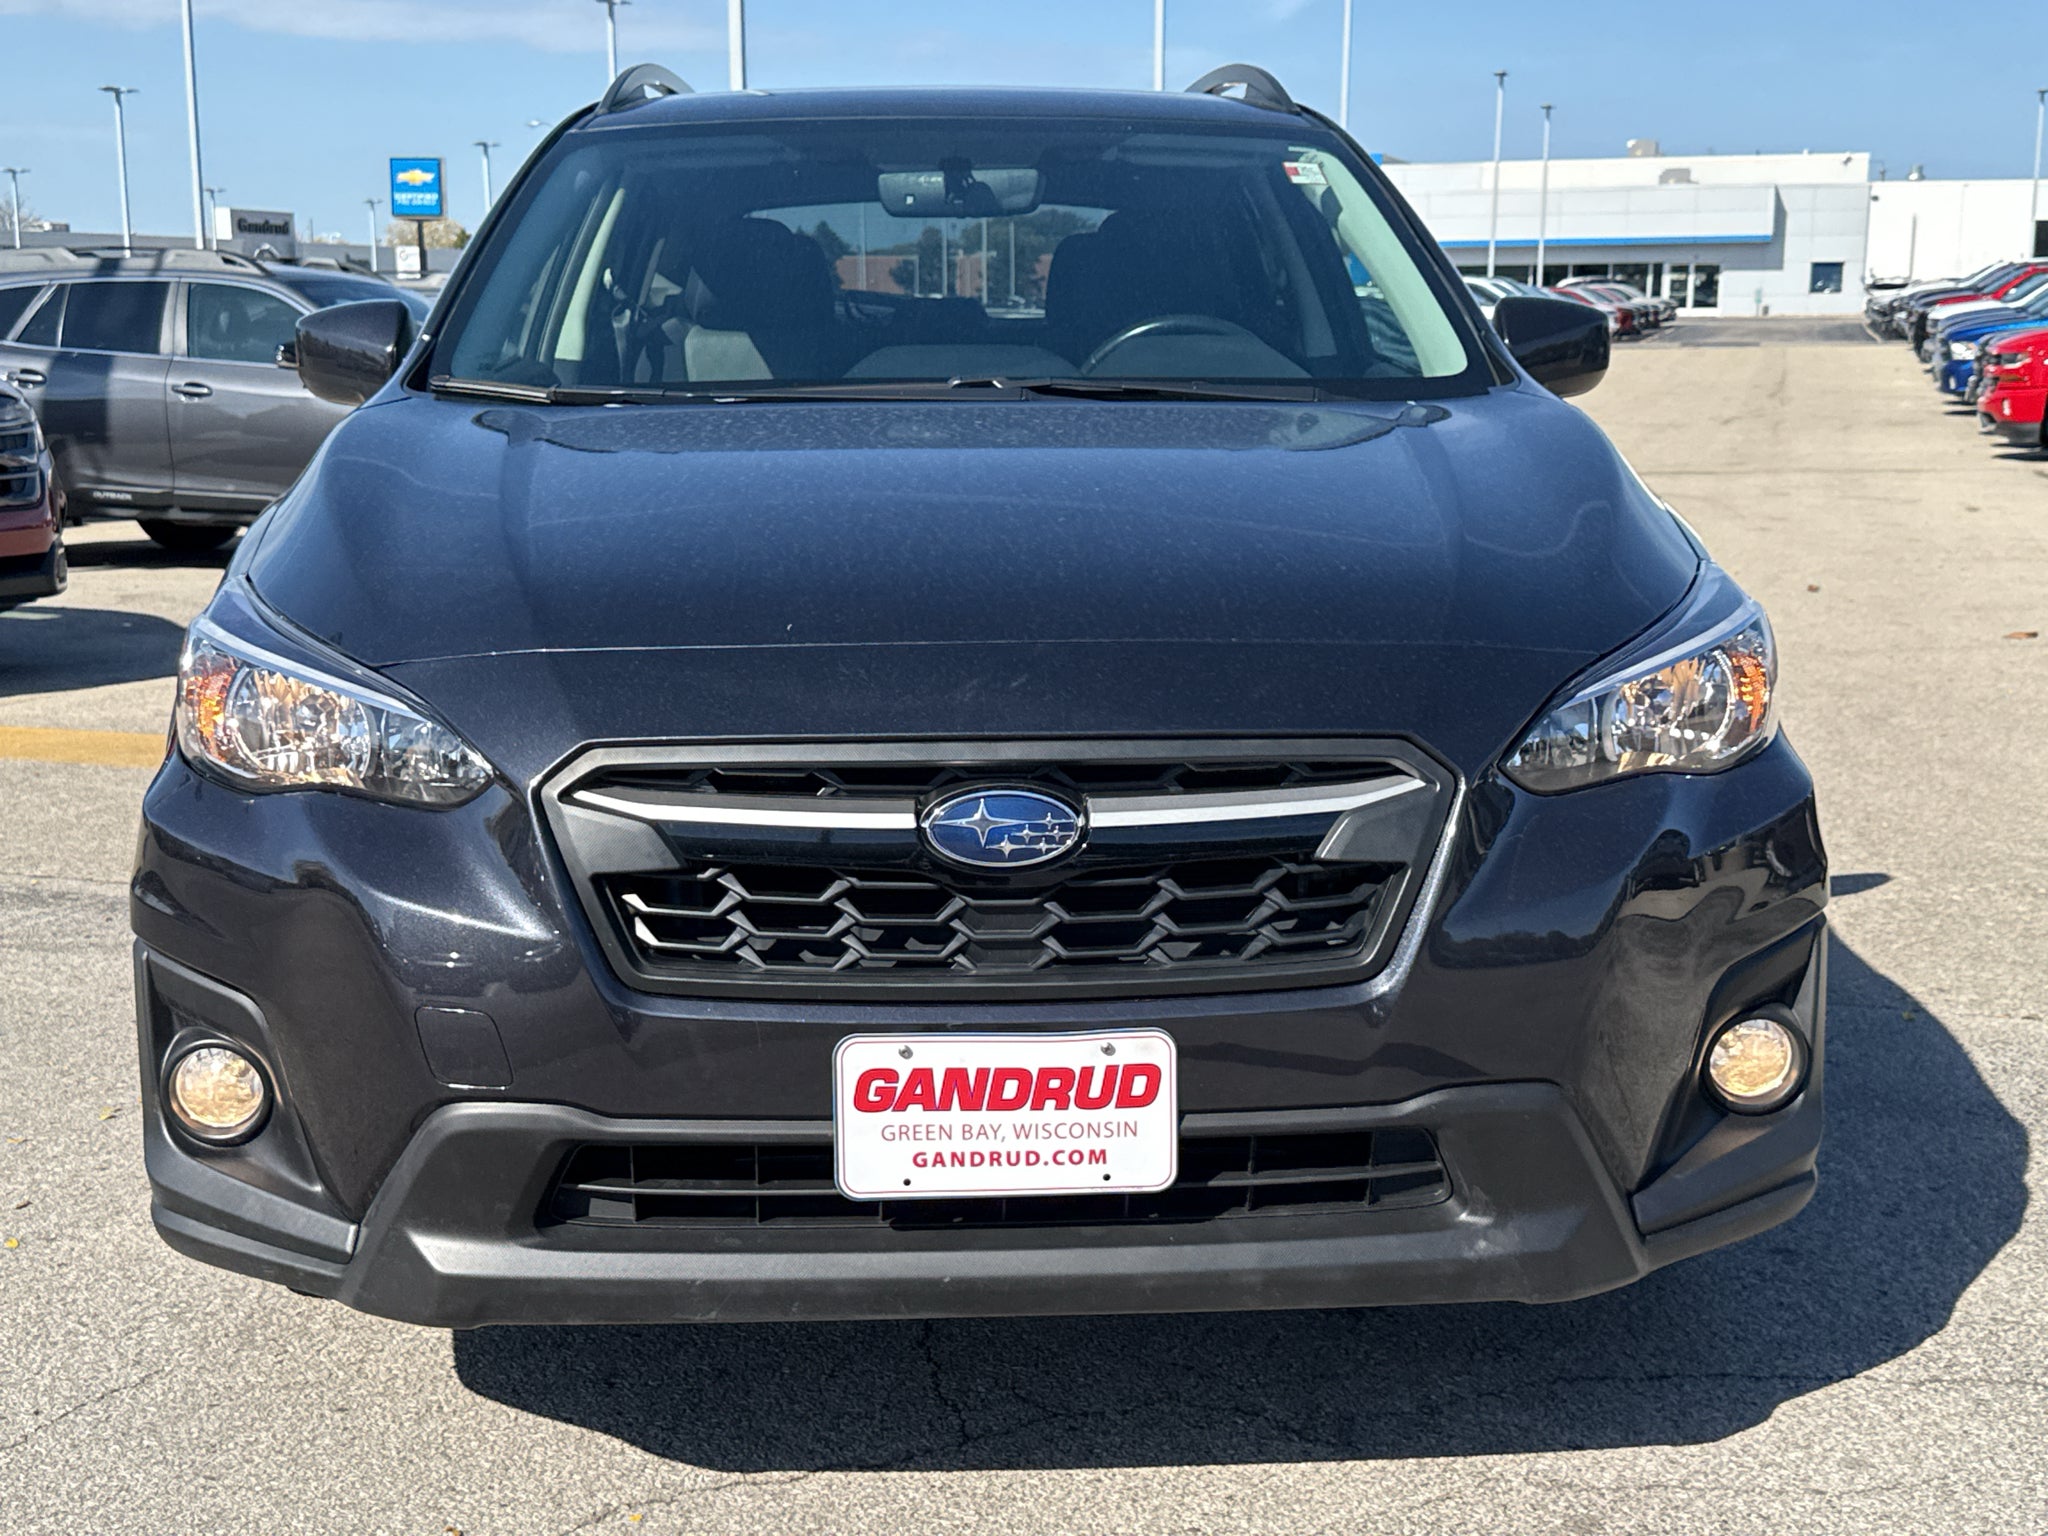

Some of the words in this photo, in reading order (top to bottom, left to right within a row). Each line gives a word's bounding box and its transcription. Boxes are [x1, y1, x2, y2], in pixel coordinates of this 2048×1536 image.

[238, 218, 289, 235] Gandrud
[853, 1063, 1162, 1113] GANDRUD
[881, 1124, 952, 1141] GREEN
[961, 1123, 1006, 1143] BAY,
[1013, 1120, 1139, 1140] WISCONSIN
[912, 1149, 1108, 1168] GANDRUD.COM
